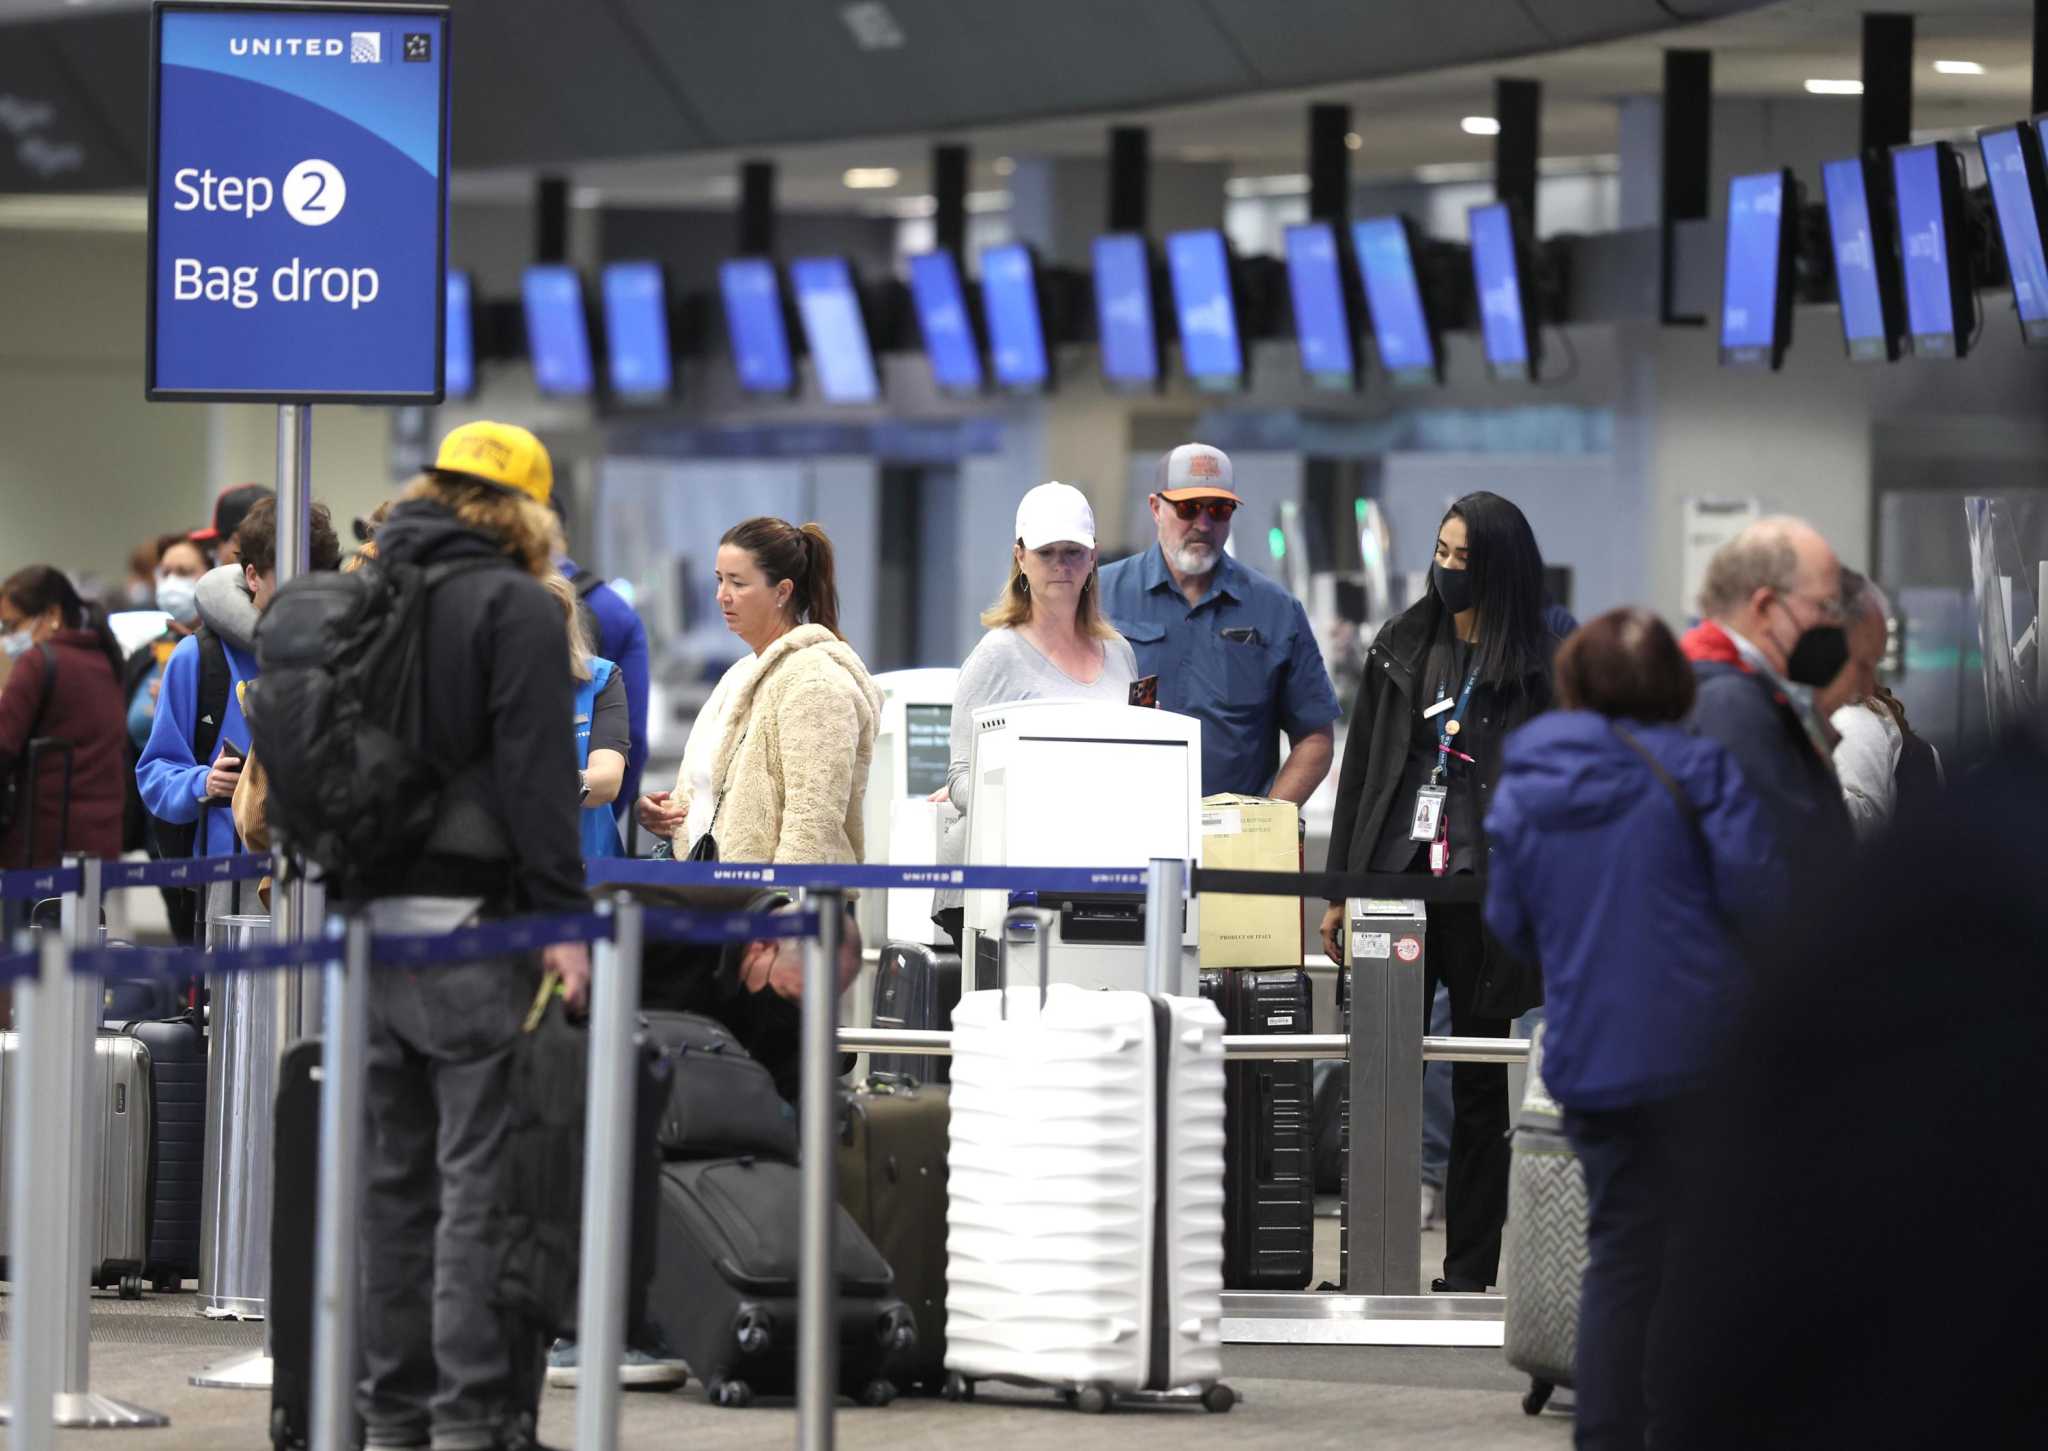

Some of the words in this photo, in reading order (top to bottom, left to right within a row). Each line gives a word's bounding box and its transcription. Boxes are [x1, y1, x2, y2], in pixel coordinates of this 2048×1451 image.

[230, 38, 343, 56] UNITED
[174, 168, 274, 219] Step
[301, 171, 326, 212] 2
[174, 258, 259, 309] Bag
[272, 258, 379, 310] drop
[713, 870, 761, 880] UNITED
[902, 872, 950, 882] UNITED
[1091, 874, 1138, 883] UNITED
